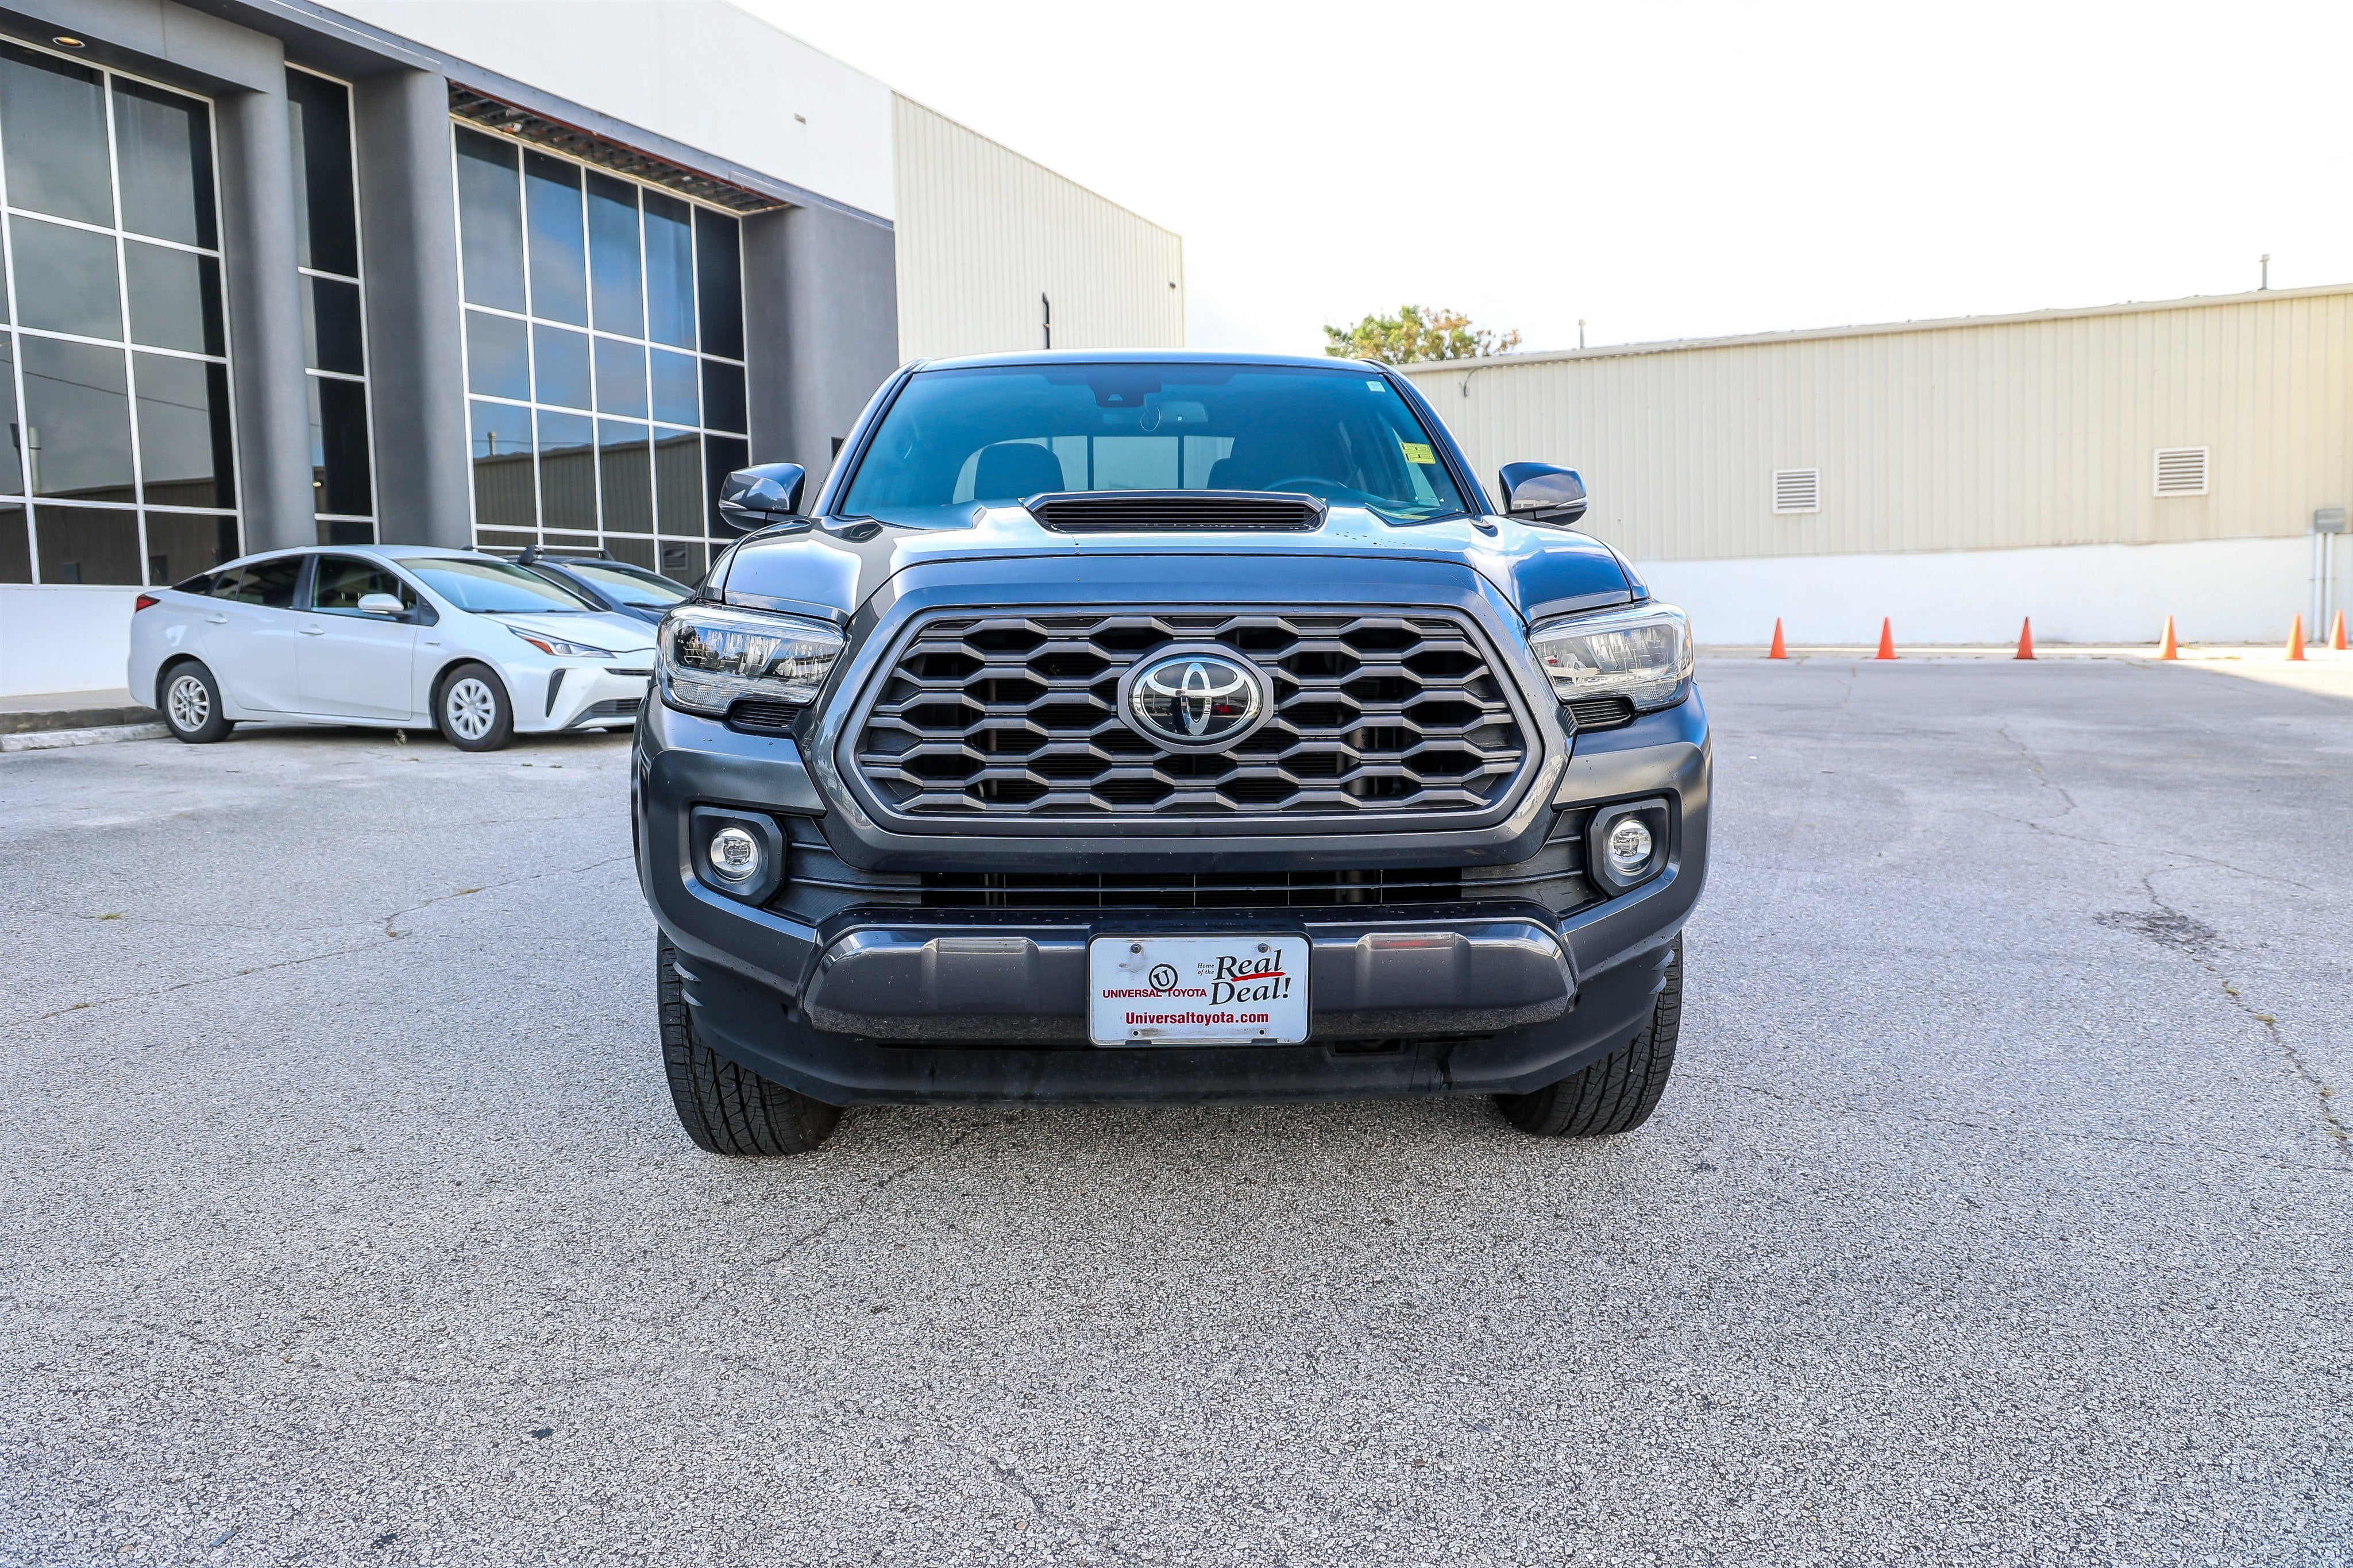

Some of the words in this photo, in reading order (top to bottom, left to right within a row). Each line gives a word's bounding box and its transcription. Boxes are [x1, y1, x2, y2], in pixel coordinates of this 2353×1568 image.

[1213, 949, 1282, 980] Real
[1102, 988, 1162, 998] UNIVERSAL
[1166, 988, 1208, 998] TOYOTA
[1209, 977, 1292, 1006] Deal!
[1125, 1011, 1270, 1026] Universaltoyota.com
